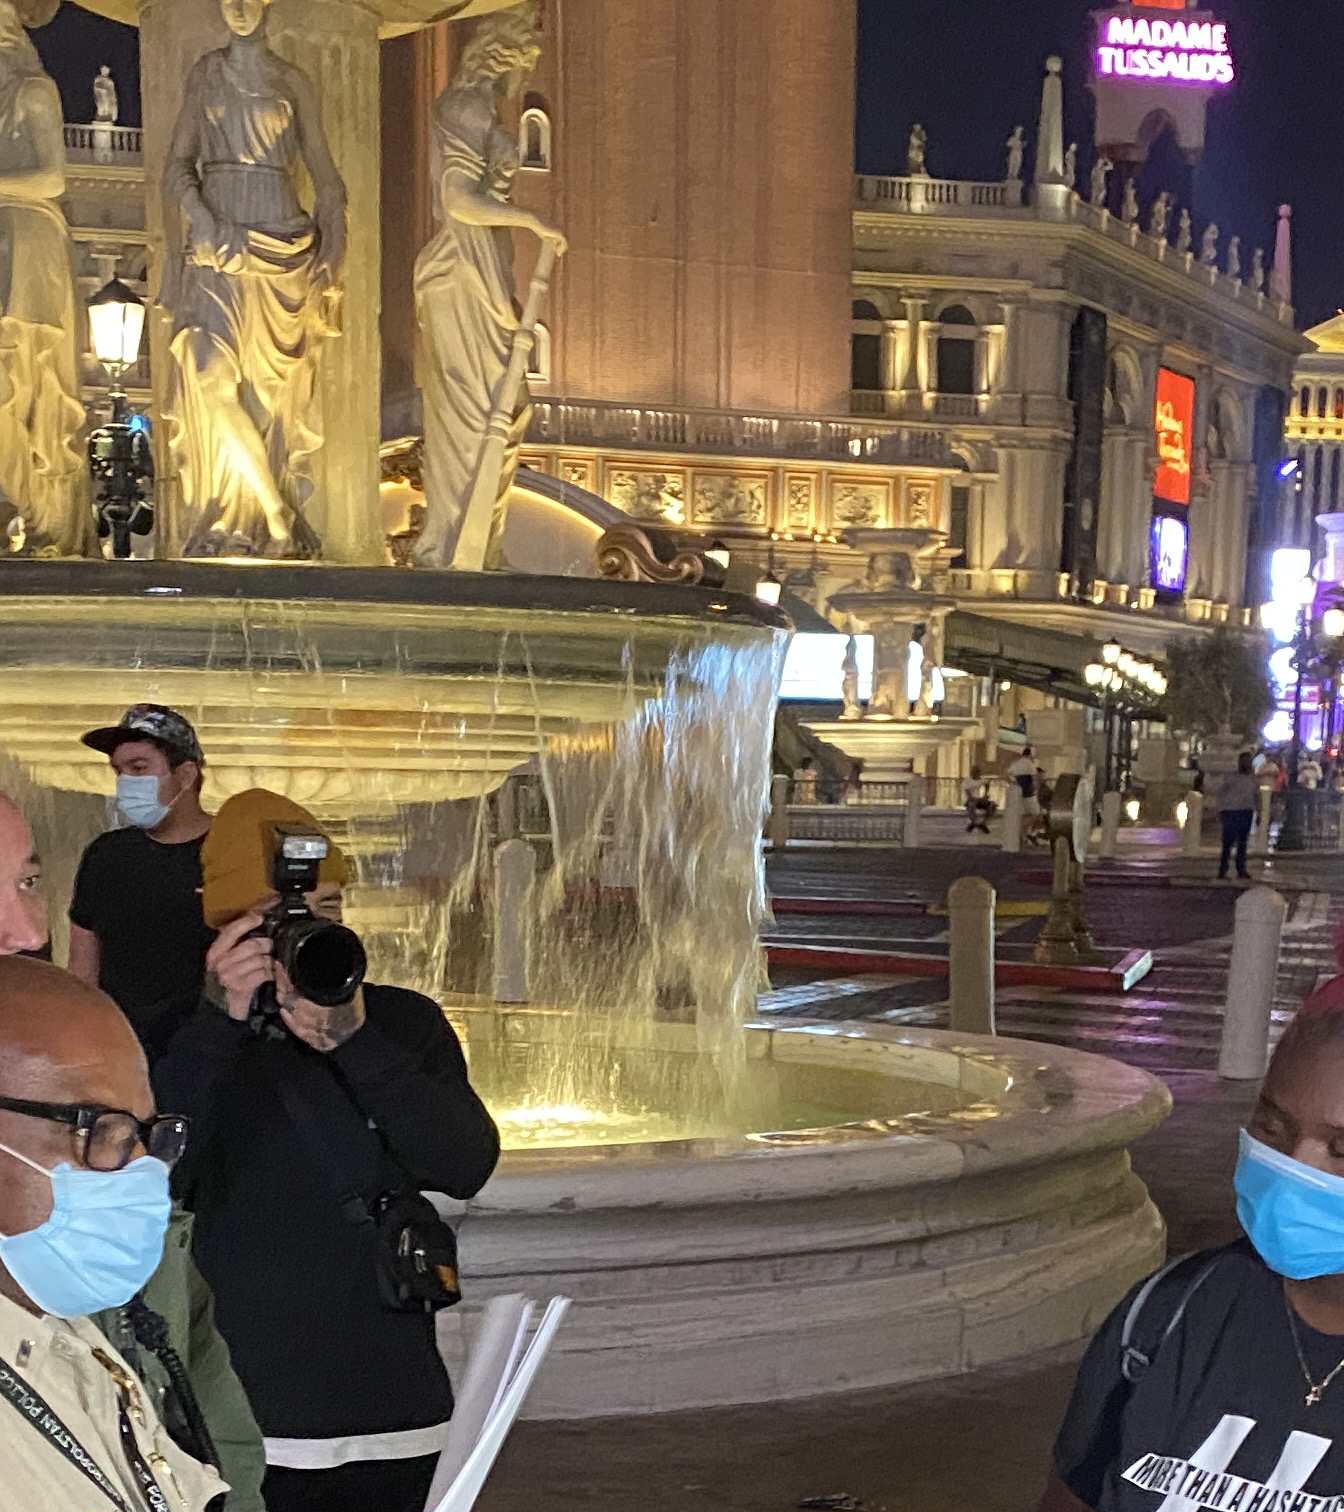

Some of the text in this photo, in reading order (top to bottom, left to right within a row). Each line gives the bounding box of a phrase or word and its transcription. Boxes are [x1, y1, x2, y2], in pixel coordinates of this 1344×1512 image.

[1108, 17, 1228, 51] MADAME
[1131, 1455, 1183, 1491] MORE
[1175, 1462, 1233, 1507] THAN
[1226, 1482, 1250, 1512] A
